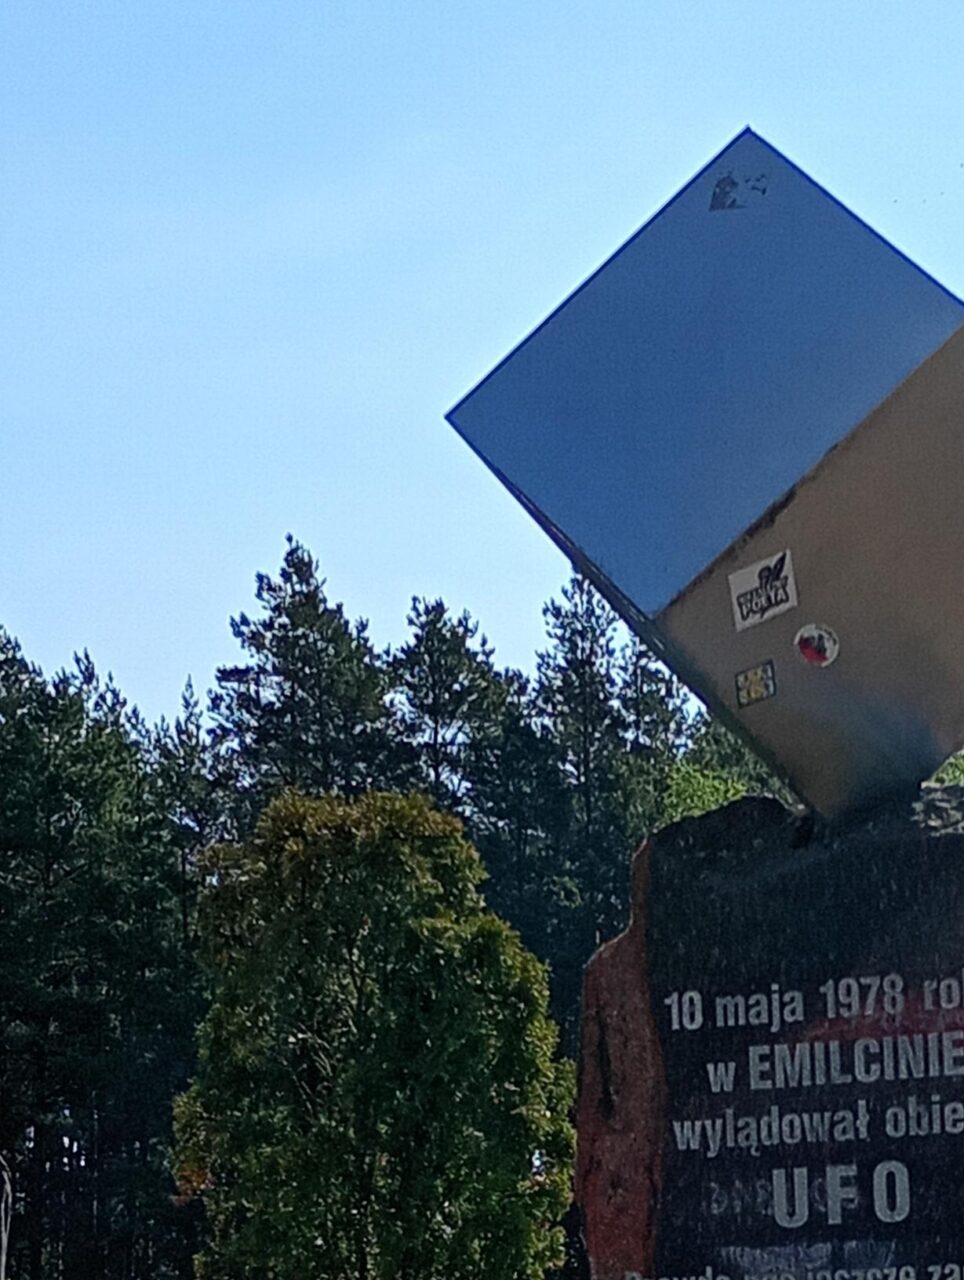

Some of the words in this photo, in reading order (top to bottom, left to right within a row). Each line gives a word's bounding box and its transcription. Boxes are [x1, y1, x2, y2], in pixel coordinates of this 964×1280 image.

[664, 990, 703, 1031] 10
[715, 983, 805, 1033] maja
[819, 973, 905, 1019] 1978
[706, 1061, 737, 1093] w
[672, 1099, 871, 1158] wylądował
